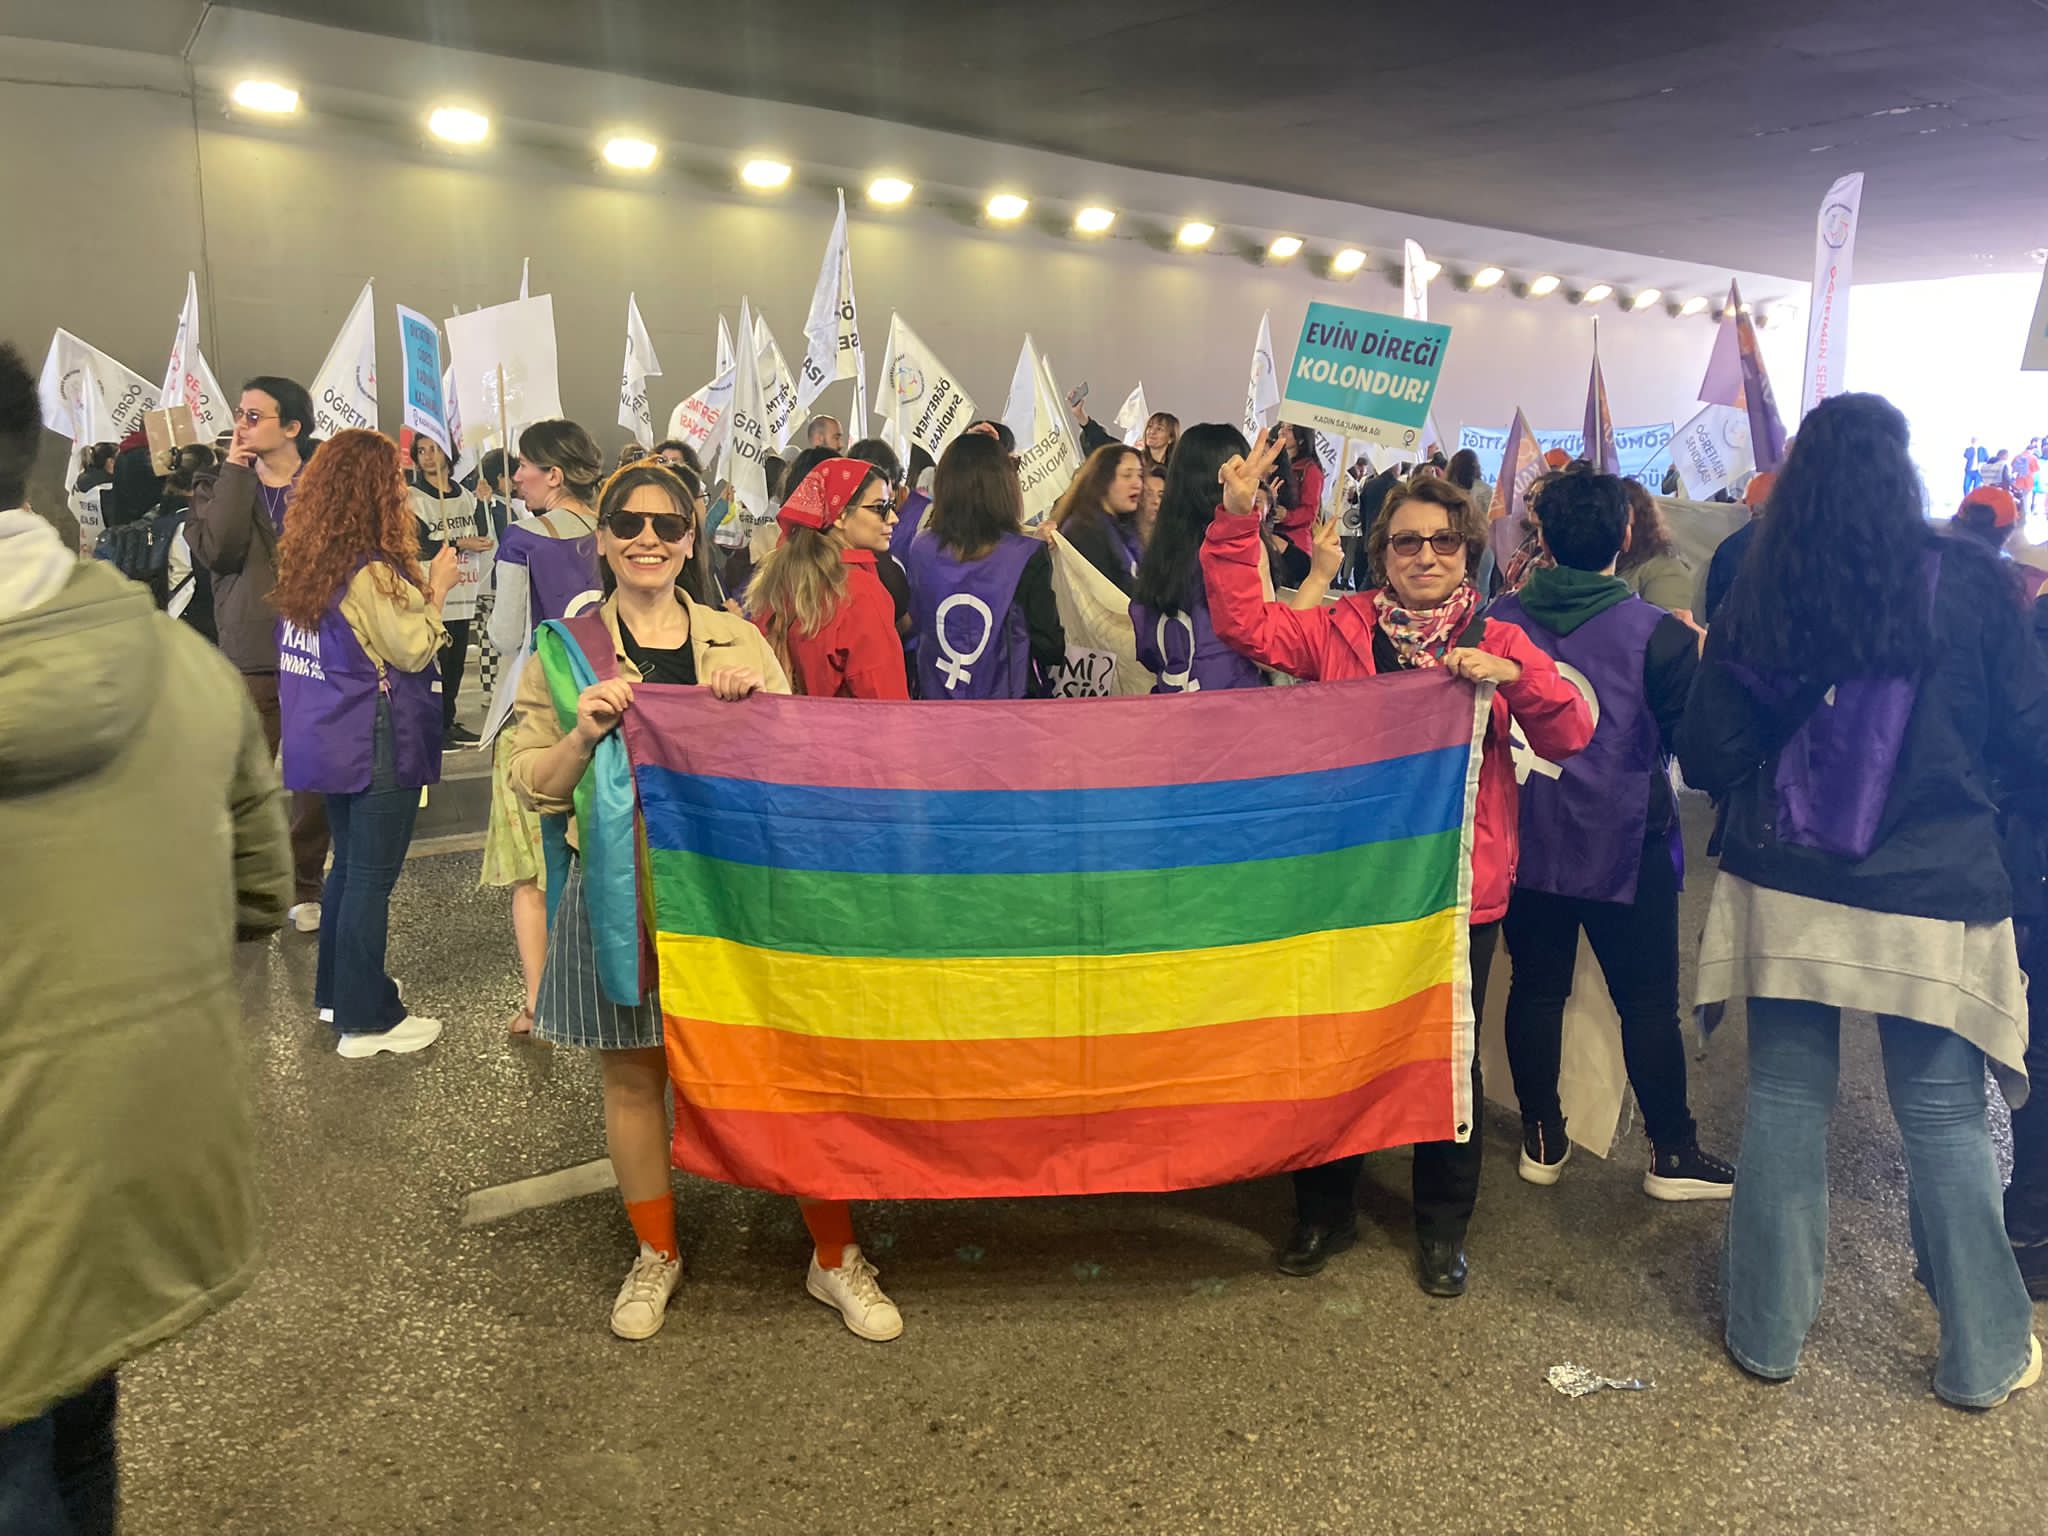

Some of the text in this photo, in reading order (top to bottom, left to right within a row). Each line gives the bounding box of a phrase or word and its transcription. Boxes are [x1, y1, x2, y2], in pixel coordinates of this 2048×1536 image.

[1306, 320, 1441, 367] EVİN DİREĞİ
[1296, 356, 1431, 404] KOLONDUR!
[1312, 415, 1335, 425] KADIN
